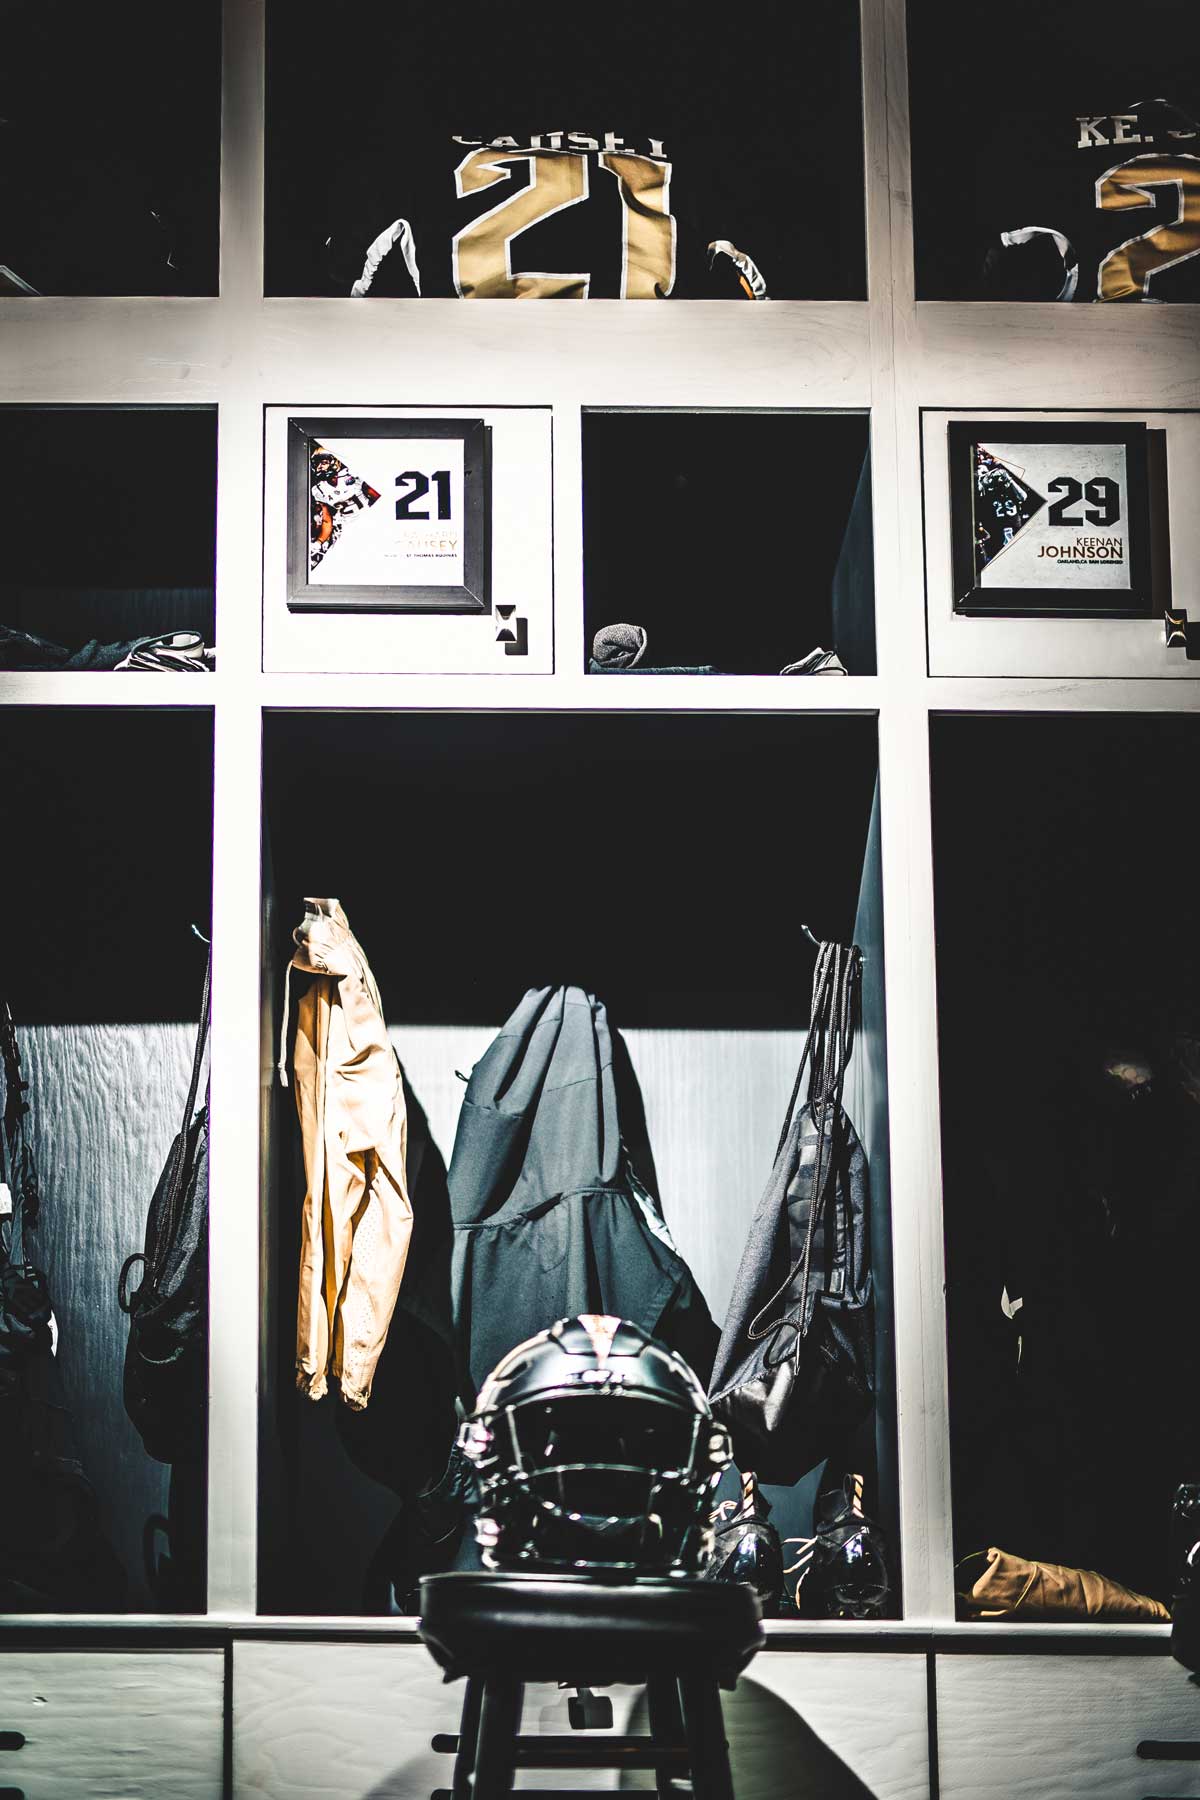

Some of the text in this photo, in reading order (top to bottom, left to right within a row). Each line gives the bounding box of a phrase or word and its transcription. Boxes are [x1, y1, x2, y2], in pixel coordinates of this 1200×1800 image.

[1076, 115, 1154, 148] KE.
[452, 147, 677, 300] 21
[395, 471, 451, 520] 21
[1048, 477, 1120, 527] 29
[394, 540, 457, 552] AUSEY
[1037, 546, 1123, 558] JOHNSON
[1077, 538, 1123, 547] KEENAN
